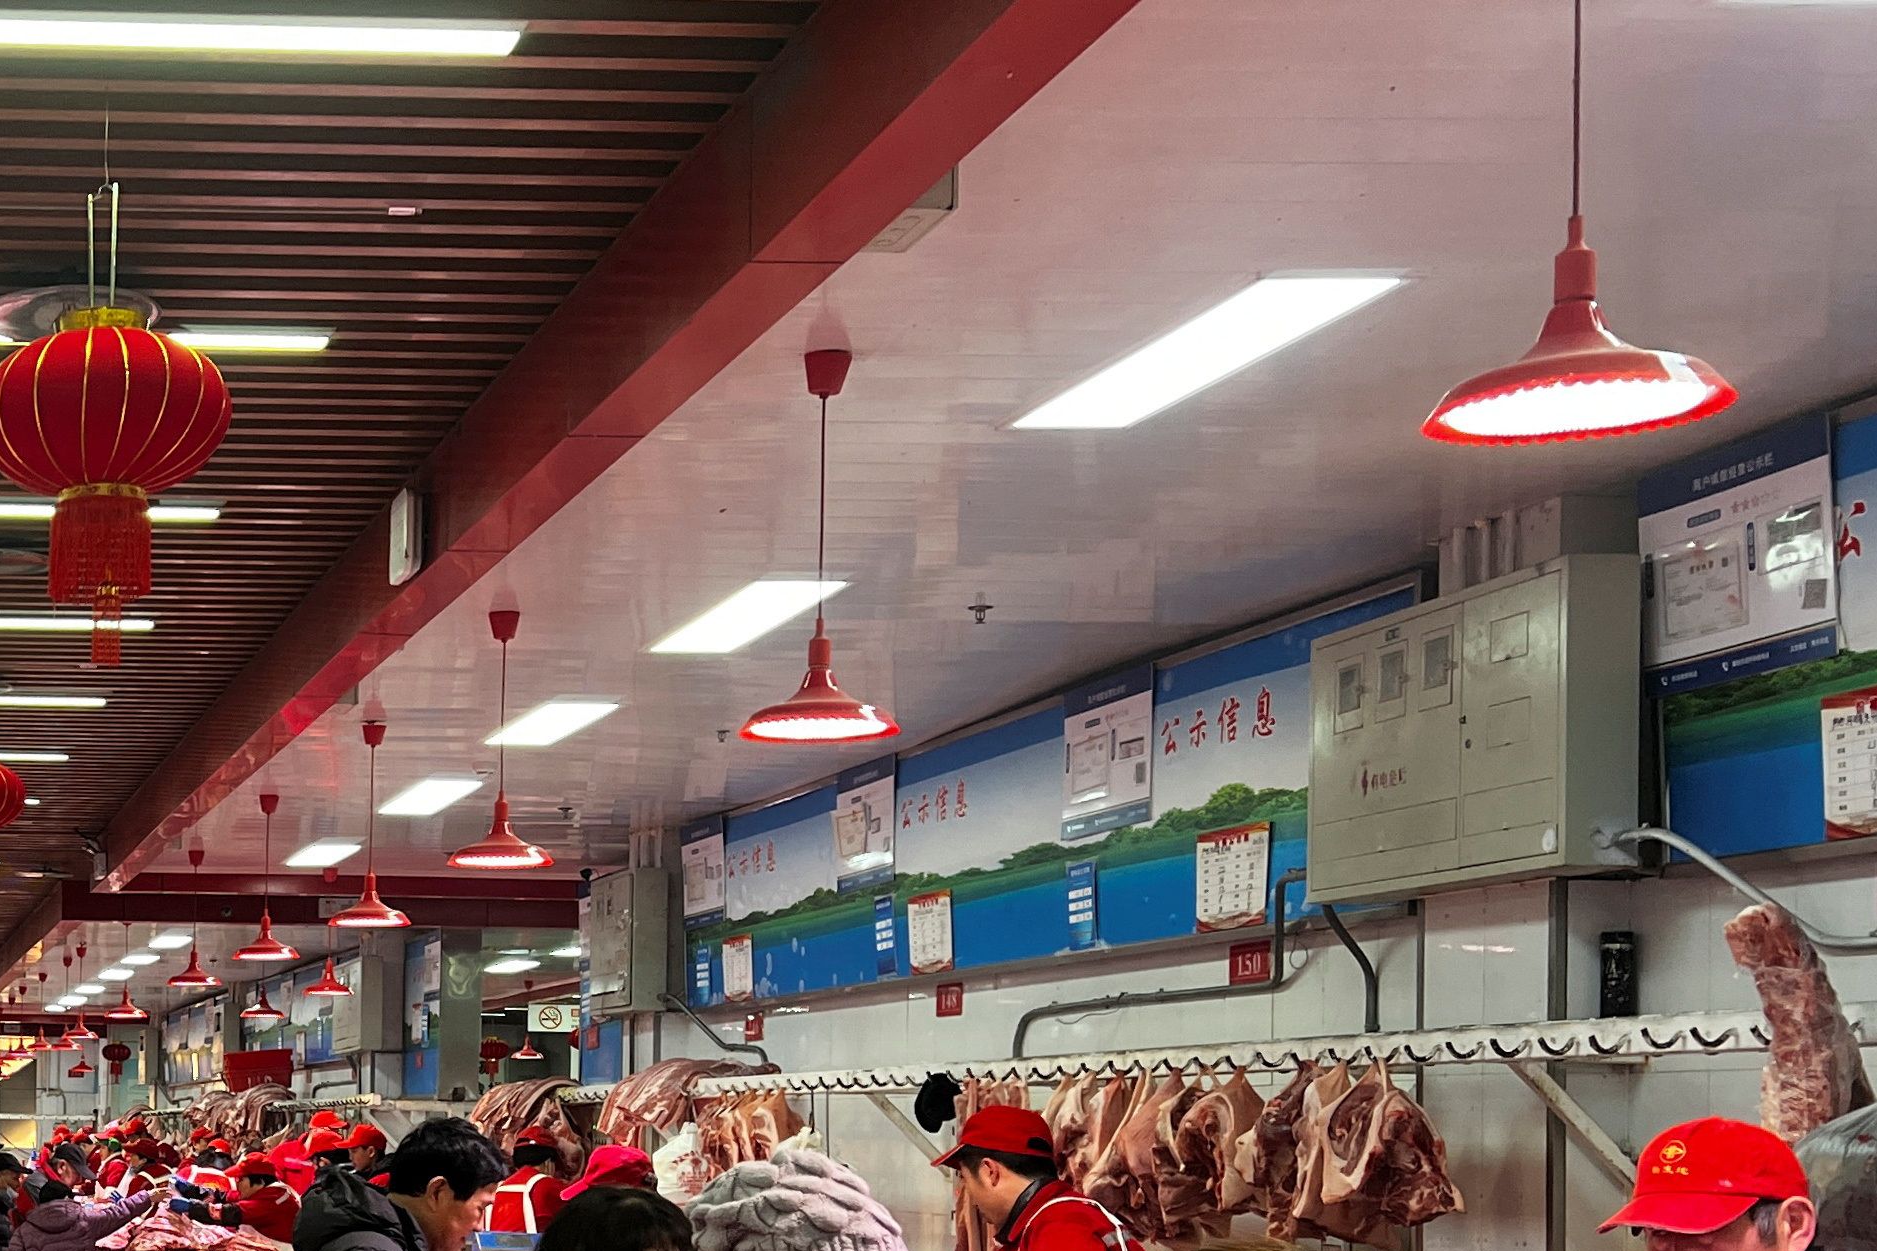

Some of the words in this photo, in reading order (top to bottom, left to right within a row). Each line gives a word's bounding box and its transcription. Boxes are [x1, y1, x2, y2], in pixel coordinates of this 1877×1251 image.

[1160, 684, 1276, 756] 公示信息
[901, 779, 967, 829] 公示信息
[727, 840, 776, 879] 公示信息
[1237, 951, 1261, 977] 150
